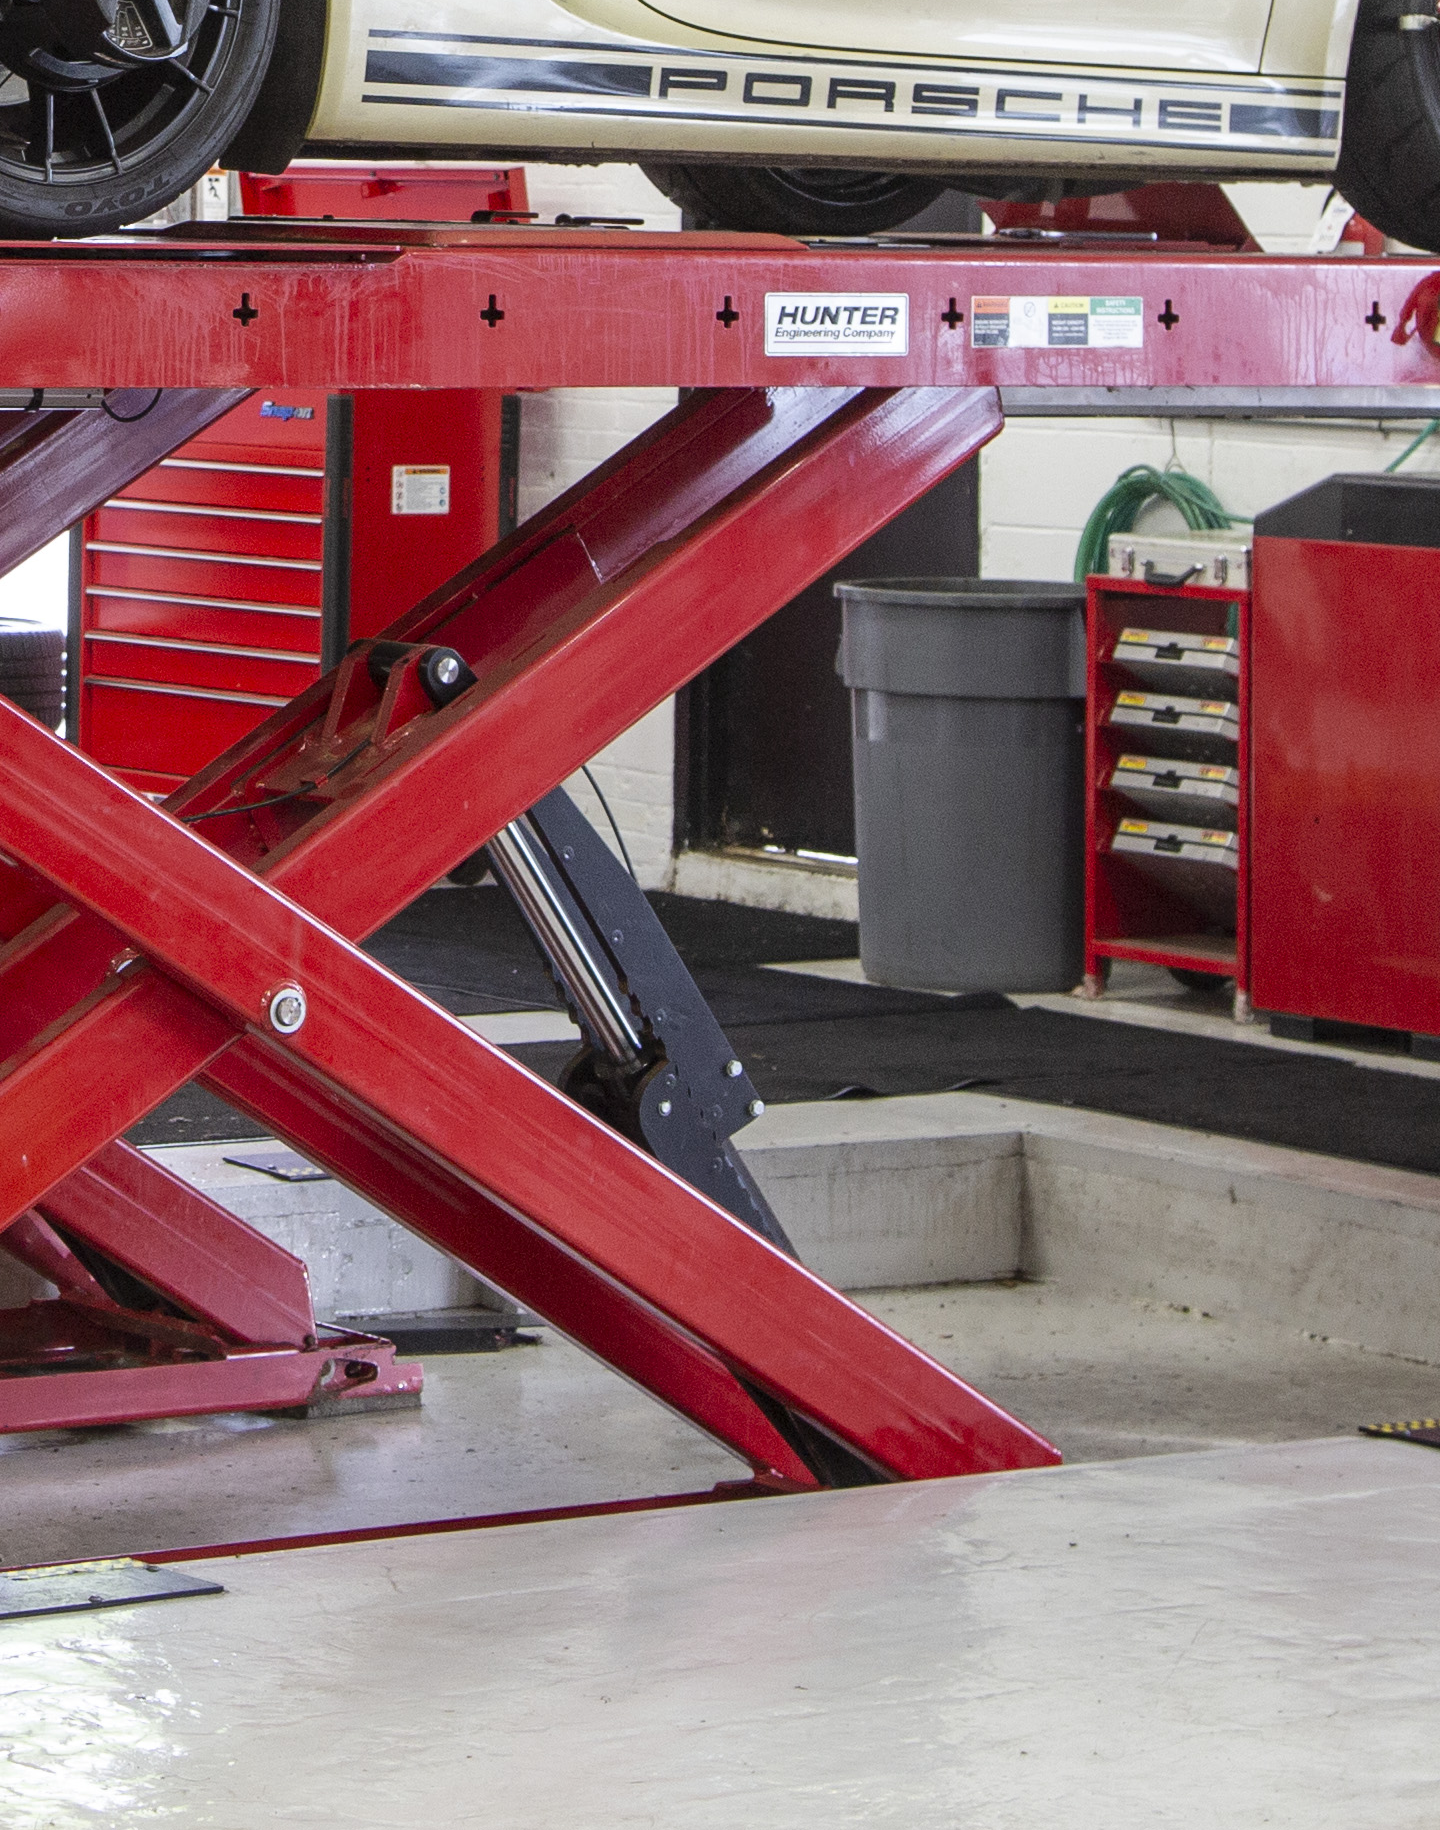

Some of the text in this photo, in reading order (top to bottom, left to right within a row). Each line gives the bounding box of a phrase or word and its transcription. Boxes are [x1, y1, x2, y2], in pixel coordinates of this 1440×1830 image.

[659, 67, 1223, 132] PORSCHE
[777, 305, 900, 325] HUNTER
[774, 326, 896, 340] Engineering Company
